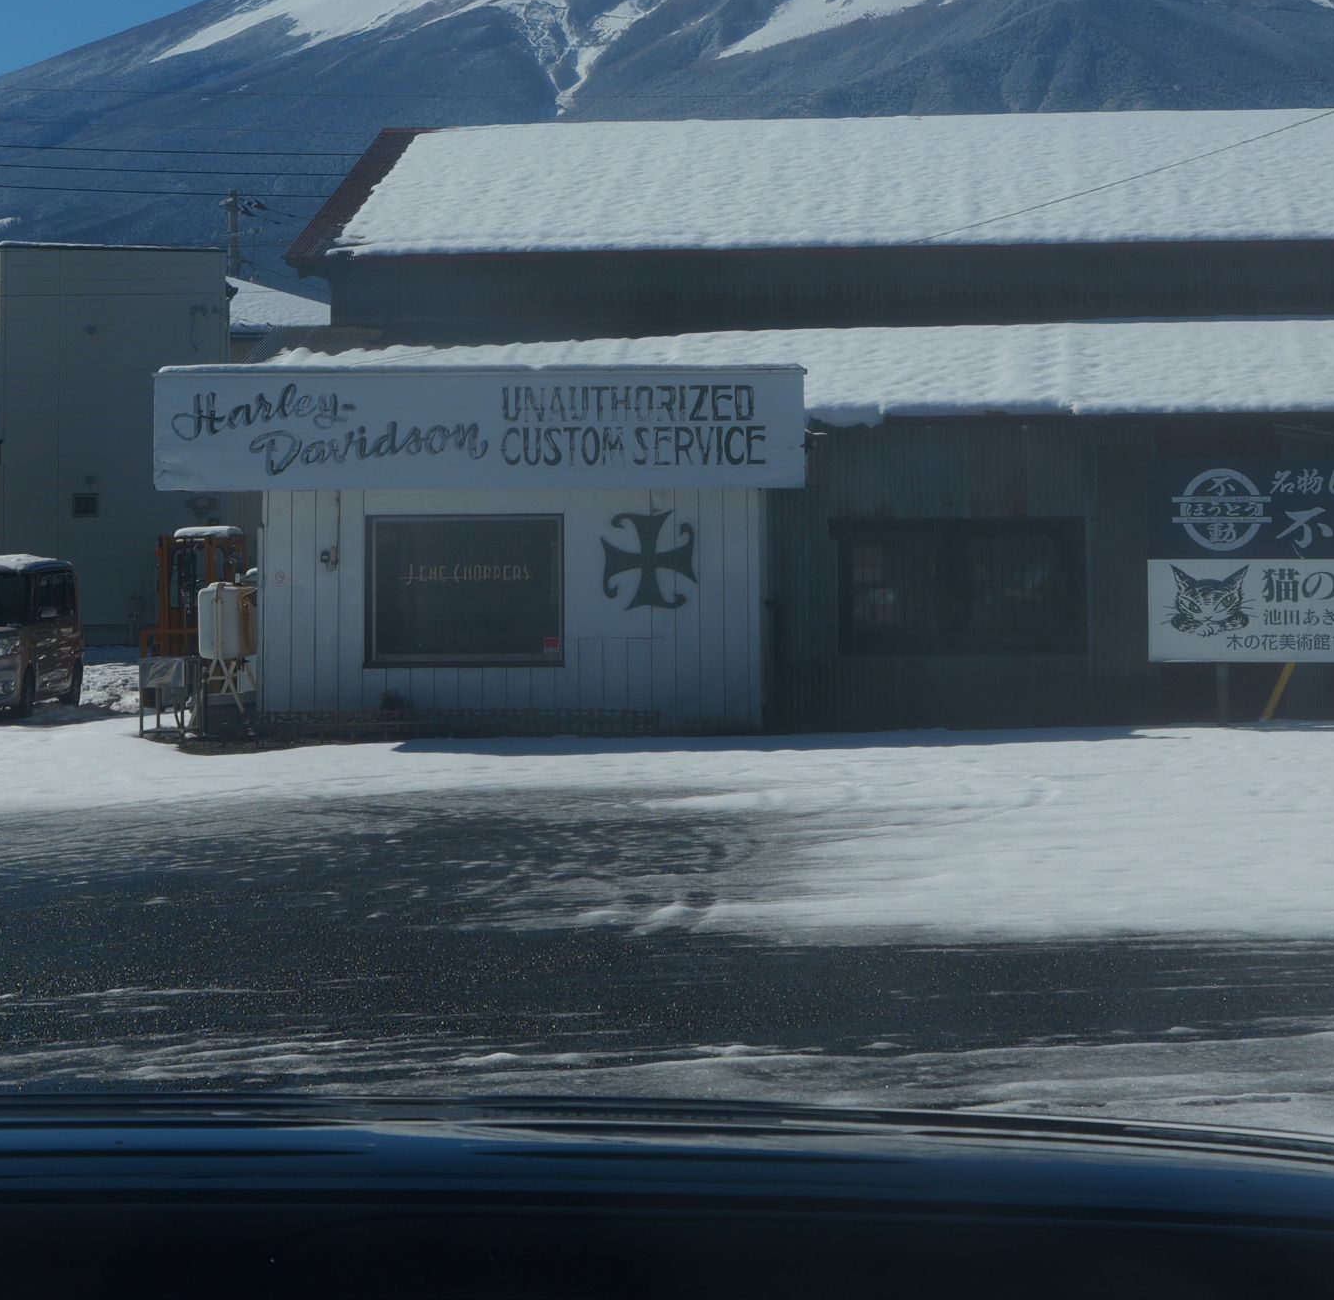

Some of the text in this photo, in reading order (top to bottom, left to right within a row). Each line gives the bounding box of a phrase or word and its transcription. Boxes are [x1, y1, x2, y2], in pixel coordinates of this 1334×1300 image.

[171, 382, 357, 441] Harley-
[500, 385, 756, 423] UNAUTHORIZED
[248, 419, 489, 477] Davidson
[500, 425, 767, 467] CUSTOM SERVICE
[1185, 501, 1259, 517] ほうとう
[1225, 633, 1331, 651] 木の花美術館
